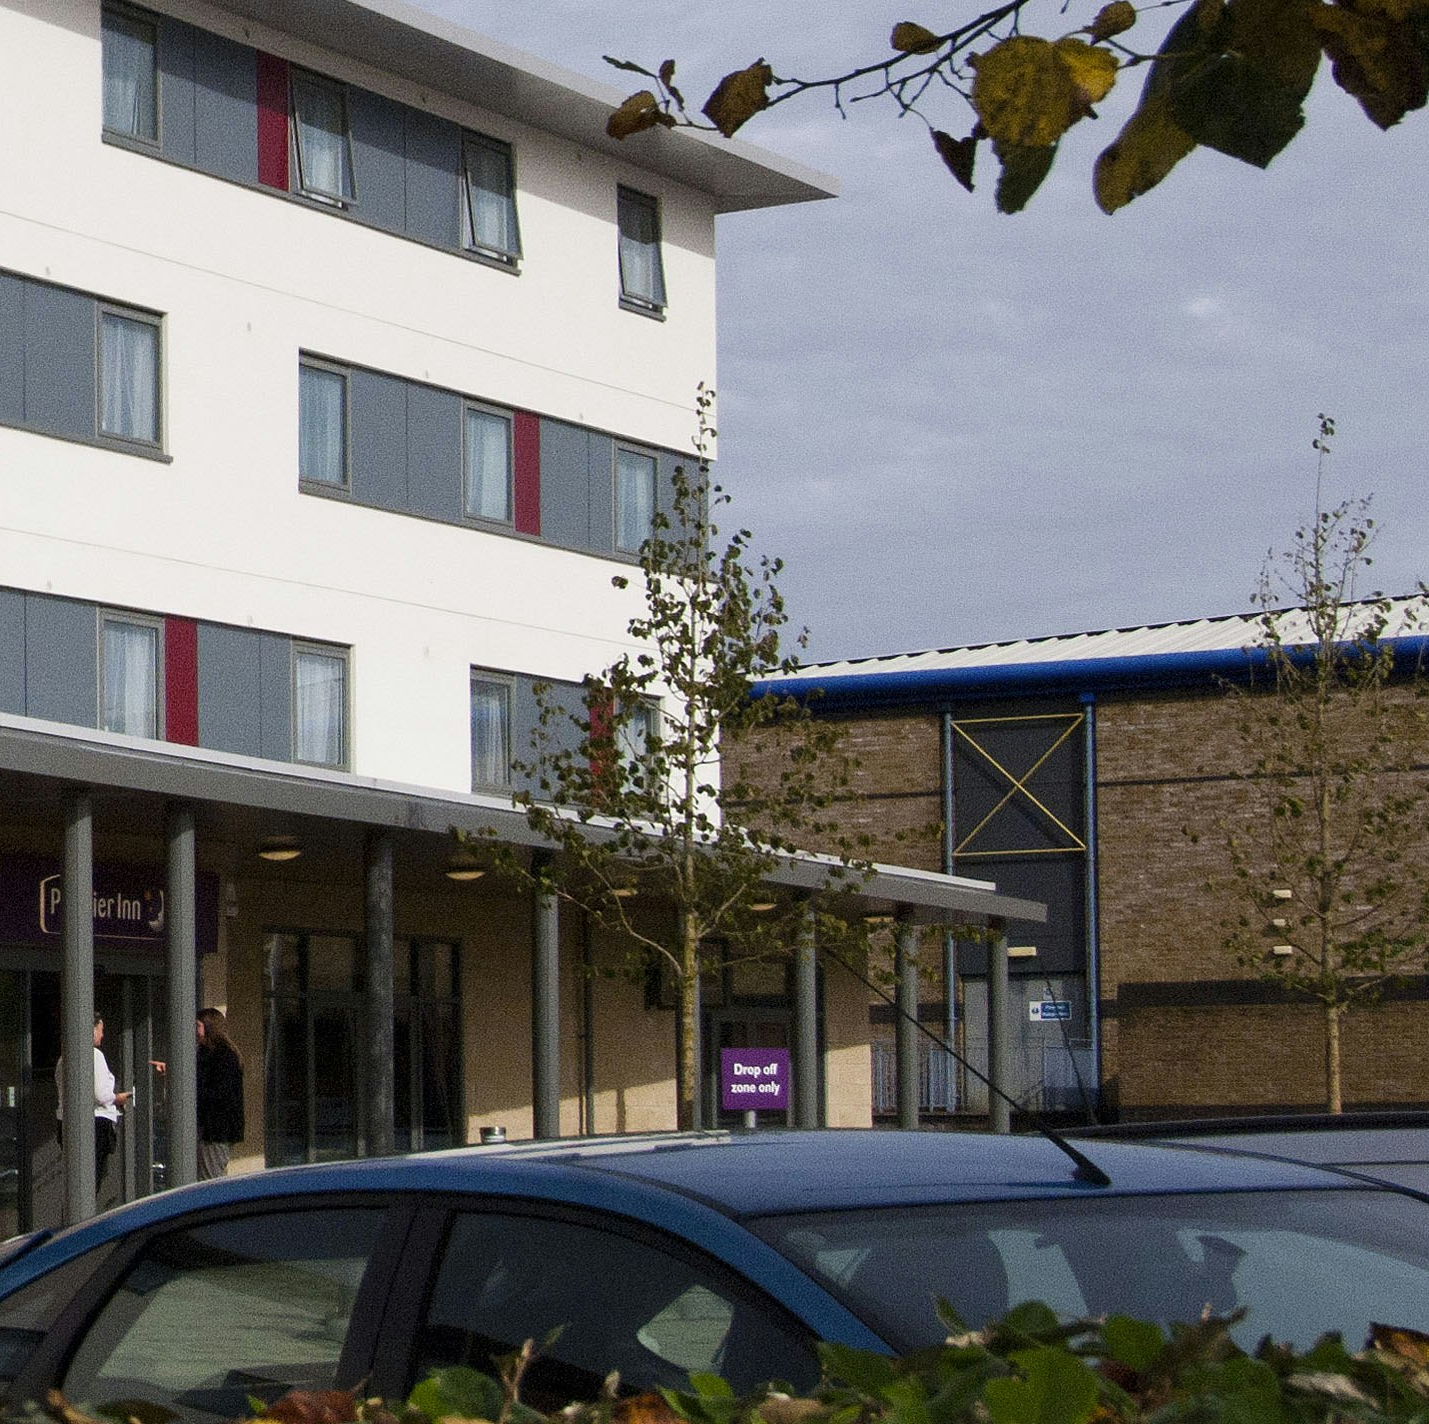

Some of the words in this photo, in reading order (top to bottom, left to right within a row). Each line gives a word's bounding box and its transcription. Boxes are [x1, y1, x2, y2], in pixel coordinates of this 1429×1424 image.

[50, 888, 114, 918] Pier
[117, 893, 141, 920] Inn
[733, 1063, 761, 1079] Drop
[762, 1062, 778, 1076] off
[731, 1082, 757, 1093] zone
[758, 1081, 780, 1096] only
